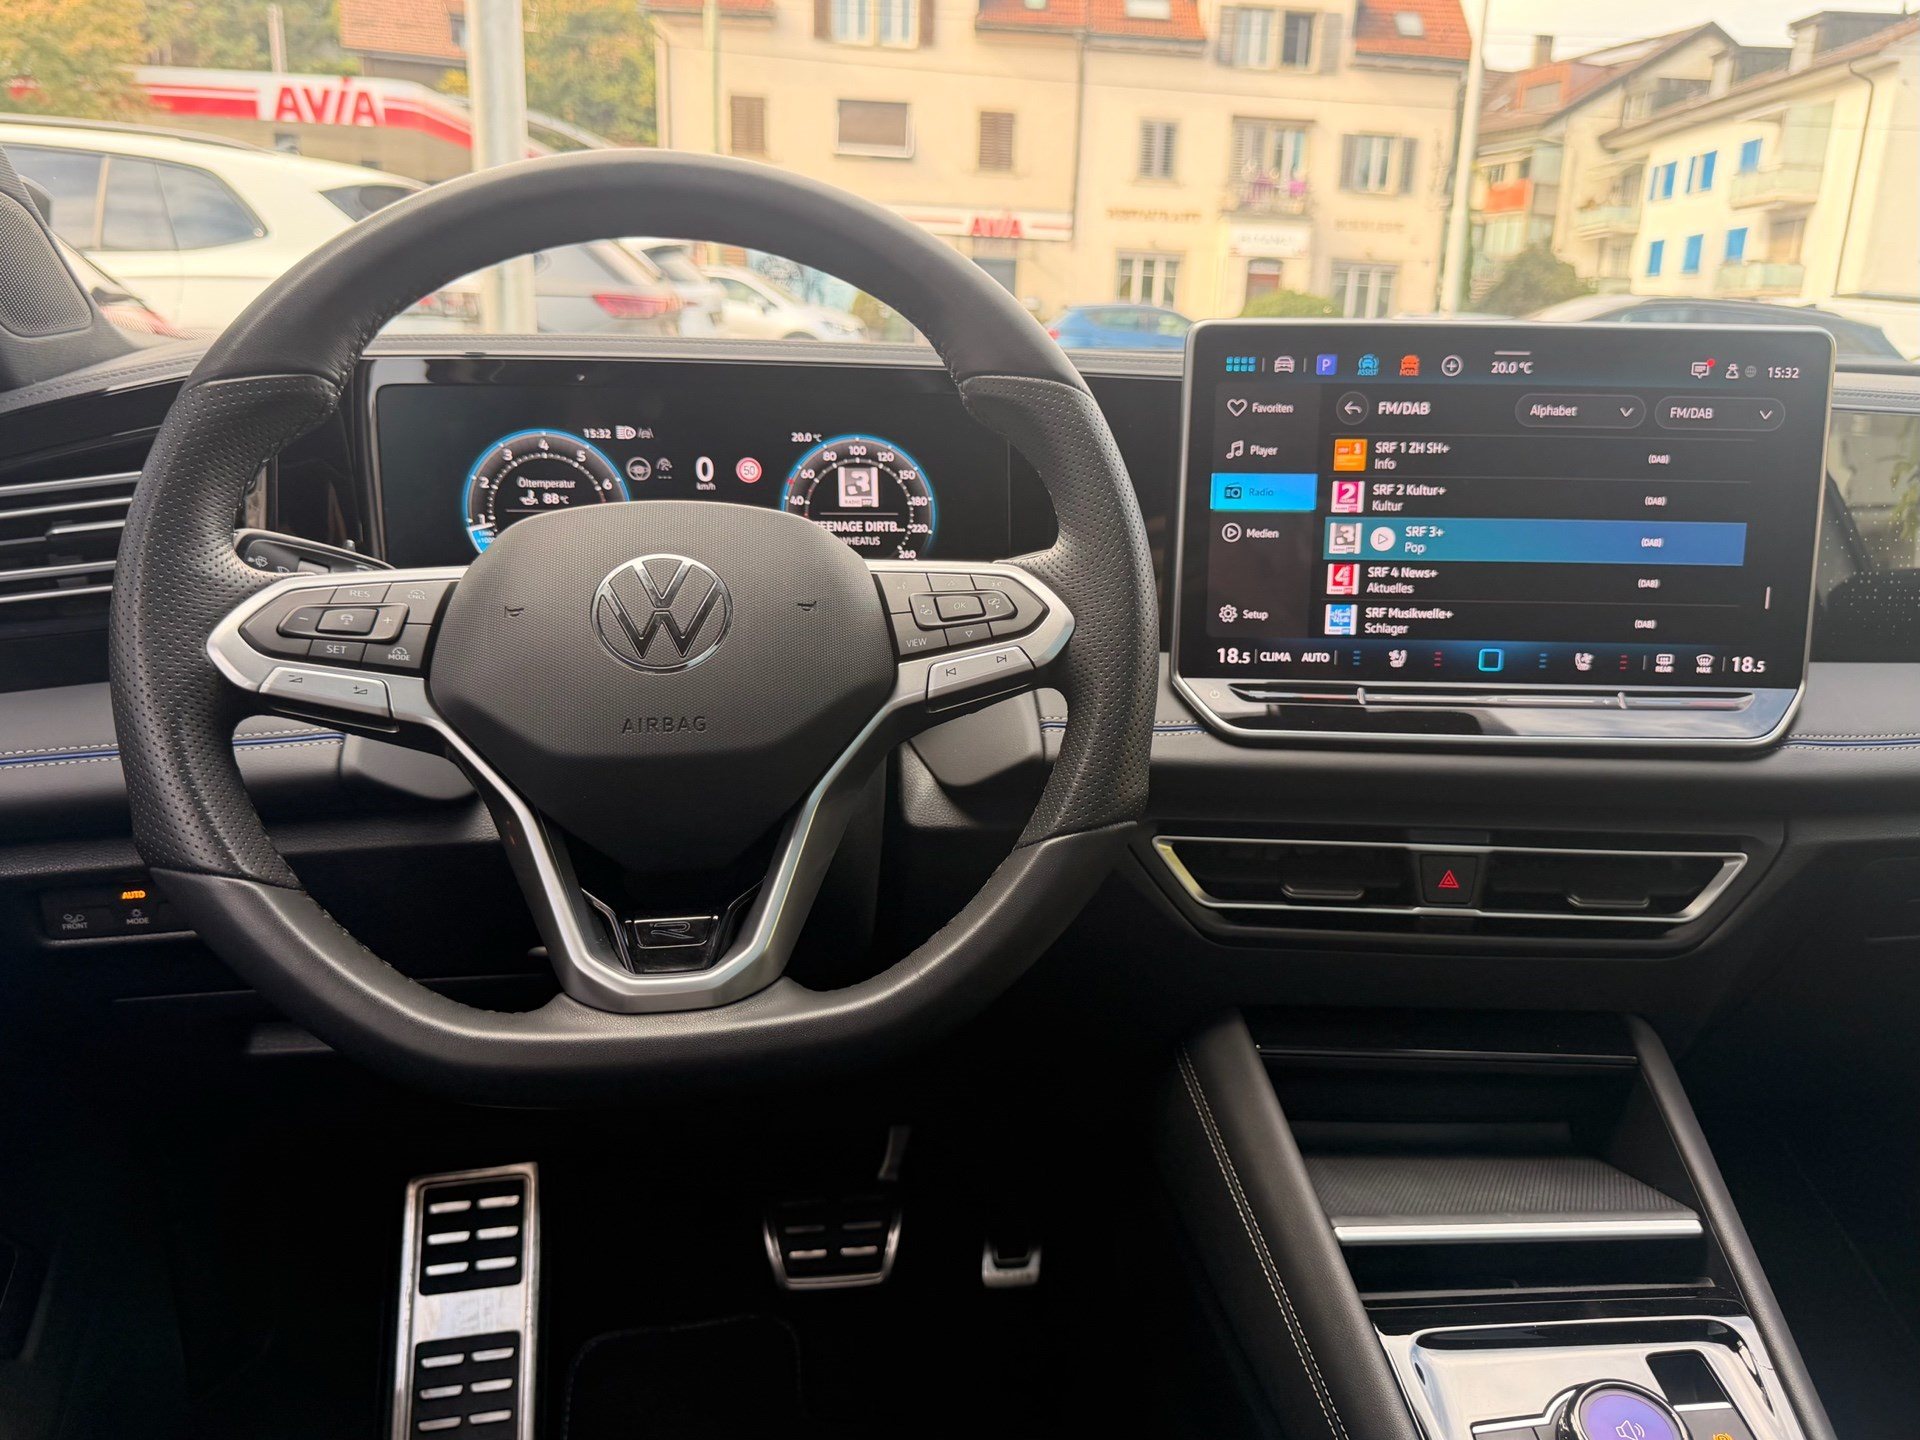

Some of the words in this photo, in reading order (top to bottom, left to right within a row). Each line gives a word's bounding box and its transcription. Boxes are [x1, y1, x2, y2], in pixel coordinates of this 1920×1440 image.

[1491, 361, 1517, 374] 20.0
[1767, 366, 1800, 379] 15:32
[1252, 401, 1294, 415] Favoriten
[1378, 401, 1431, 415] FM/DAB
[1529, 403, 1577, 418] Alphabet
[1669, 406, 1713, 420] FM/DAB
[583, 427, 612, 439] 15:32
[538, 438, 550, 451] 4
[849, 445, 867, 456] 100
[1375, 441, 1398, 454] SRF
[1400, 442, 1407, 454] 1
[1408, 442, 1425, 454] ZH
[1426, 442, 1451, 454] SH+
[502, 448, 513, 461] 3
[576, 449, 587, 463] 5
[823, 451, 837, 462] 80
[1250, 444, 1279, 458] Player
[877, 452, 895, 463] 120
[1648, 454, 1671, 465] (DAB)
[695, 456, 714, 482] 0
[1374, 458, 1397, 470] Info
[743, 465, 756, 476] 50
[801, 469, 815, 480] 60
[899, 469, 916, 481] 150
[478, 475, 490, 489] 2
[602, 478, 613, 491] 6
[696, 482, 716, 491] km/h
[1249, 487, 1274, 497] Radio
[1372, 484, 1395, 496] SRF
[1396, 484, 1405, 496] 2
[1406, 484, 1447, 496] Kultur+
[542, 492, 560, 505] 88
[789, 496, 805, 507] 40
[911, 496, 928, 507] 180
[1645, 496, 1668, 506] (DAB)
[1372, 500, 1404, 512] Kultur
[911, 523, 928, 534] 220
[1246, 528, 1280, 539] Medien
[1405, 526, 1428, 537] SRF
[1428, 526, 1445, 538] 3+
[1404, 542, 1427, 555] Pop
[1641, 537, 1664, 548] (DAB)
[898, 550, 916, 559] 260
[1367, 566, 1390, 578] SRF
[1390, 567, 1400, 578] 4
[1400, 567, 1439, 579] News+
[1366, 582, 1415, 594] Aktuelles
[1637, 578, 1661, 589] (DAB)
[349, 590, 371, 598] RES
[953, 602, 967, 610] OK
[1242, 609, 1269, 621] Setup
[1365, 607, 1387, 619] SRF
[1388, 608, 1454, 620] Musikwelle+
[1364, 622, 1410, 637] Schlager
[1634, 619, 1657, 630] (DAB)
[906, 638, 928, 648] VIEW
[326, 645, 347, 654] SET
[1217, 647, 1251, 664] 18.5
[388, 653, 411, 661] MODE
[1259, 651, 1292, 662] CLIMA
[1301, 652, 1331, 663] AUTO
[1654, 665, 1674, 673] REAR
[1695, 666, 1713, 674] MAX
[1731, 655, 1767, 673] 18.5
[621, 715, 707, 735] AIRBAG
[122, 890, 146, 899] AUTO
[62, 922, 88, 930] FRONT
[126, 917, 149, 925] MODE
